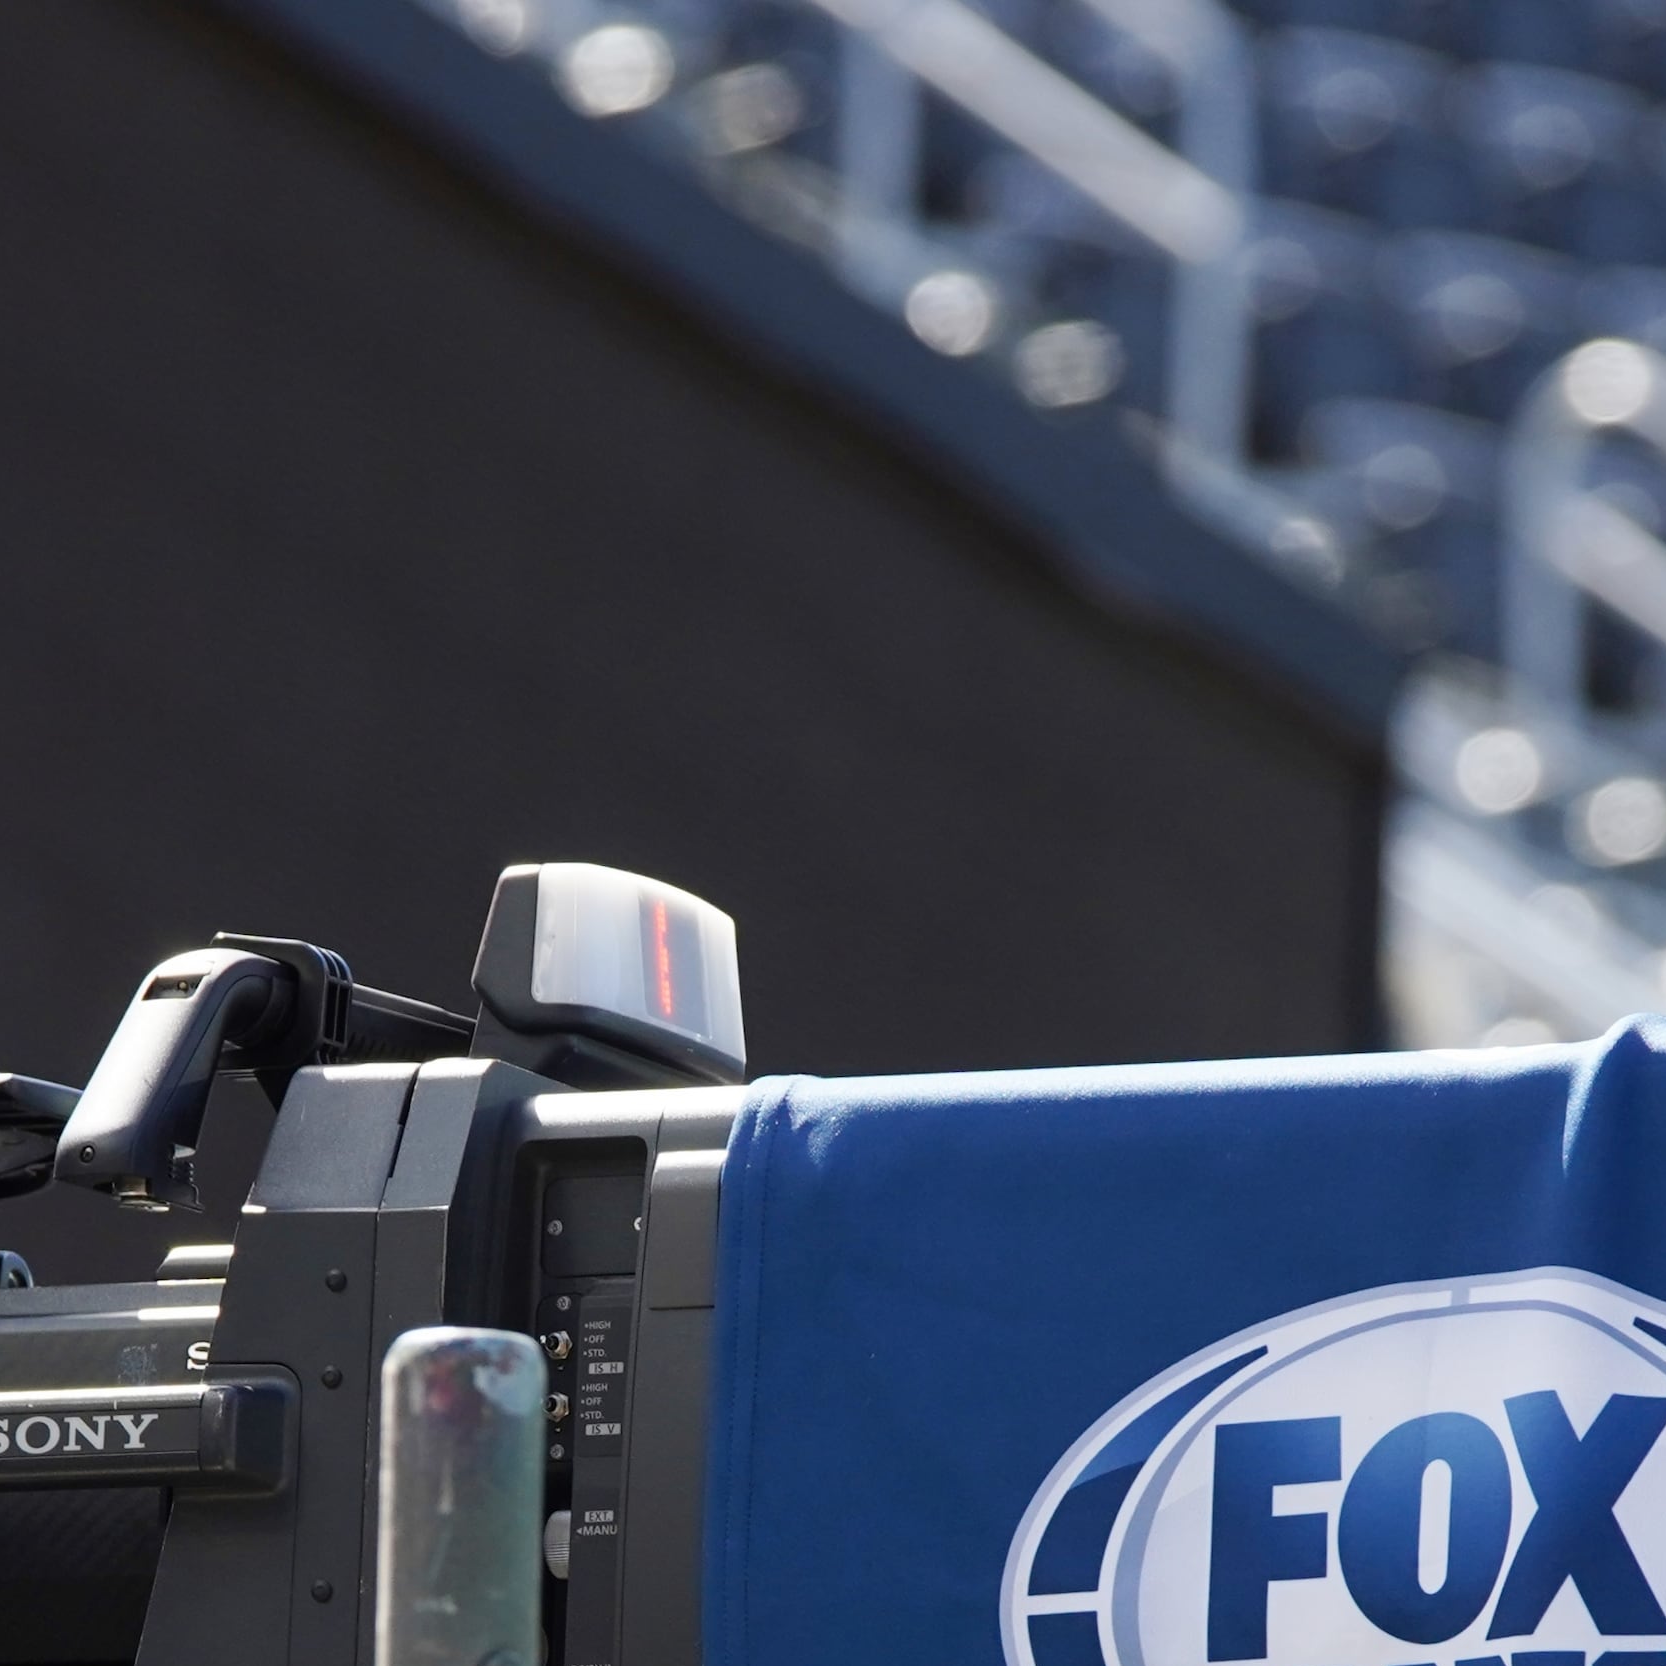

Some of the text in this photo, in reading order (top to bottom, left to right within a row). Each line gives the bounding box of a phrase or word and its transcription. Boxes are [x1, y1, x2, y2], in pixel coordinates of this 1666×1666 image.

[588, 1321, 612, 1330] HIGH
[588, 1335, 605, 1344] OFF
[609, 1363, 619, 1373] H
[585, 1383, 609, 1392] HIGH
[585, 1397, 602, 1406] OFF
[607, 1423, 616, 1434] V
[588, 1511, 611, 1523] EXT.
